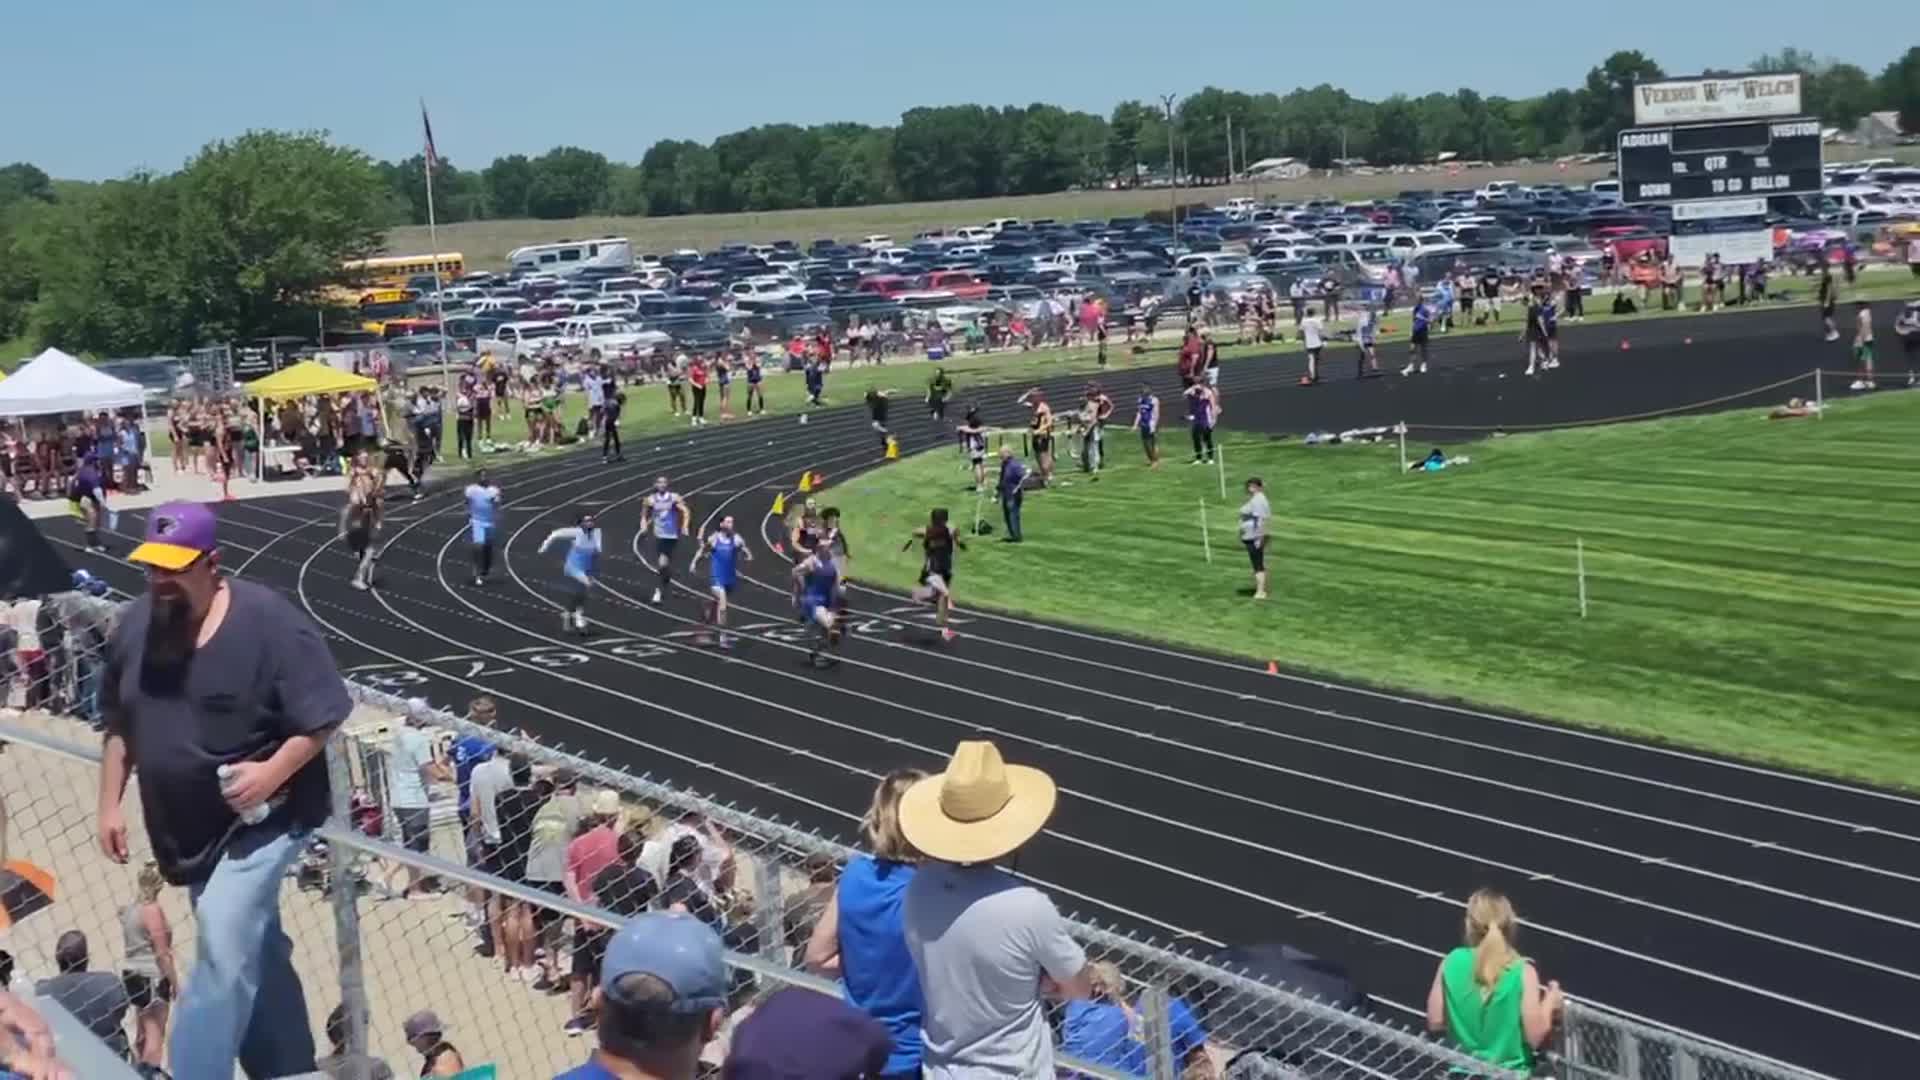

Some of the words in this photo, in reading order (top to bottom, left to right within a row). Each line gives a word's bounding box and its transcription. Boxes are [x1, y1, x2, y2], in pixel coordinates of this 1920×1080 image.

[1743, 79, 1795, 99] WELCH
[1771, 123, 1820, 137] VISITOR
[1622, 132, 1668, 147] ADRIAN
[1704, 155, 1728, 172] QTR
[1640, 183, 1671, 197] DOWN
[1712, 179, 1726, 192] TO
[1727, 178, 1742, 192] GO
[1751, 176, 1774, 190] BALL
[1775, 175, 1790, 188] ON
